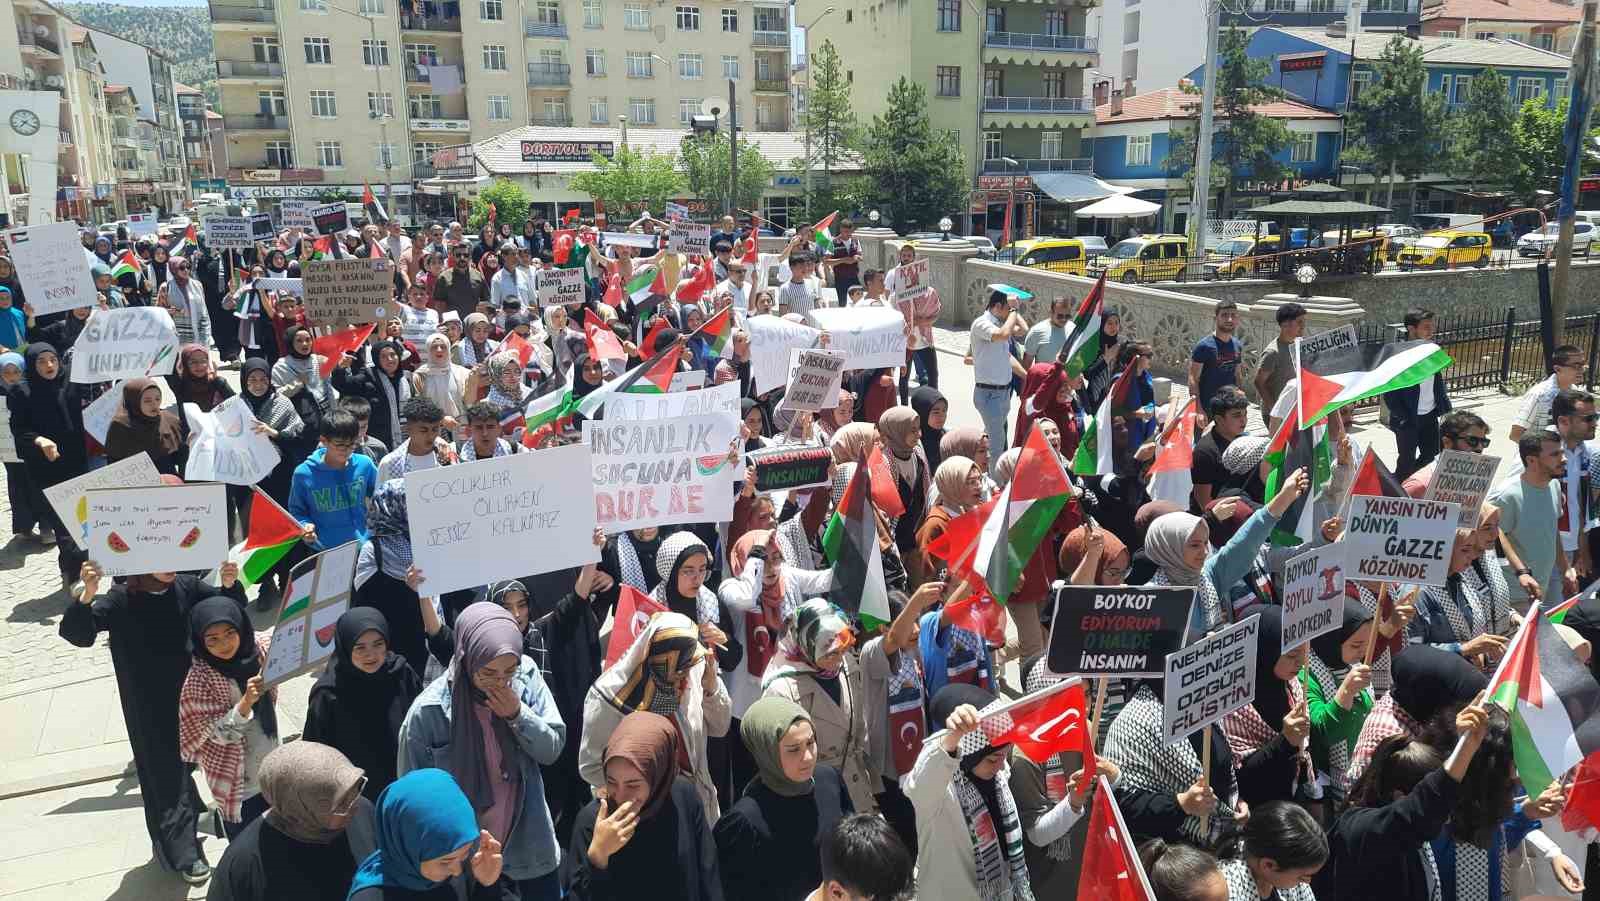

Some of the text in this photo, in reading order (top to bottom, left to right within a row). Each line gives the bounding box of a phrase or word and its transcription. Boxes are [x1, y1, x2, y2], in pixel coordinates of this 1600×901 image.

[596, 485, 659, 523] DUR
[1365, 499, 1414, 517] YANSIN
[1417, 501, 1448, 520] TÜM
[1350, 515, 1399, 535] DÜNYA
[1384, 536, 1446, 560] GAZZE
[1286, 555, 1320, 585] BOYKOT
[1358, 556, 1429, 580] KÖZÜNDE
[1094, 594, 1157, 610] BOYKOT
[1285, 586, 1314, 613] SOYLU
[1080, 613, 1161, 631] EDİYORUM
[1170, 621, 1257, 673] NEHİRDEN
[1079, 651, 1148, 670] İNSANIM
[1181, 646, 1246, 688] DENİZE
[1170, 682, 1251, 737] FİLİSTİN
